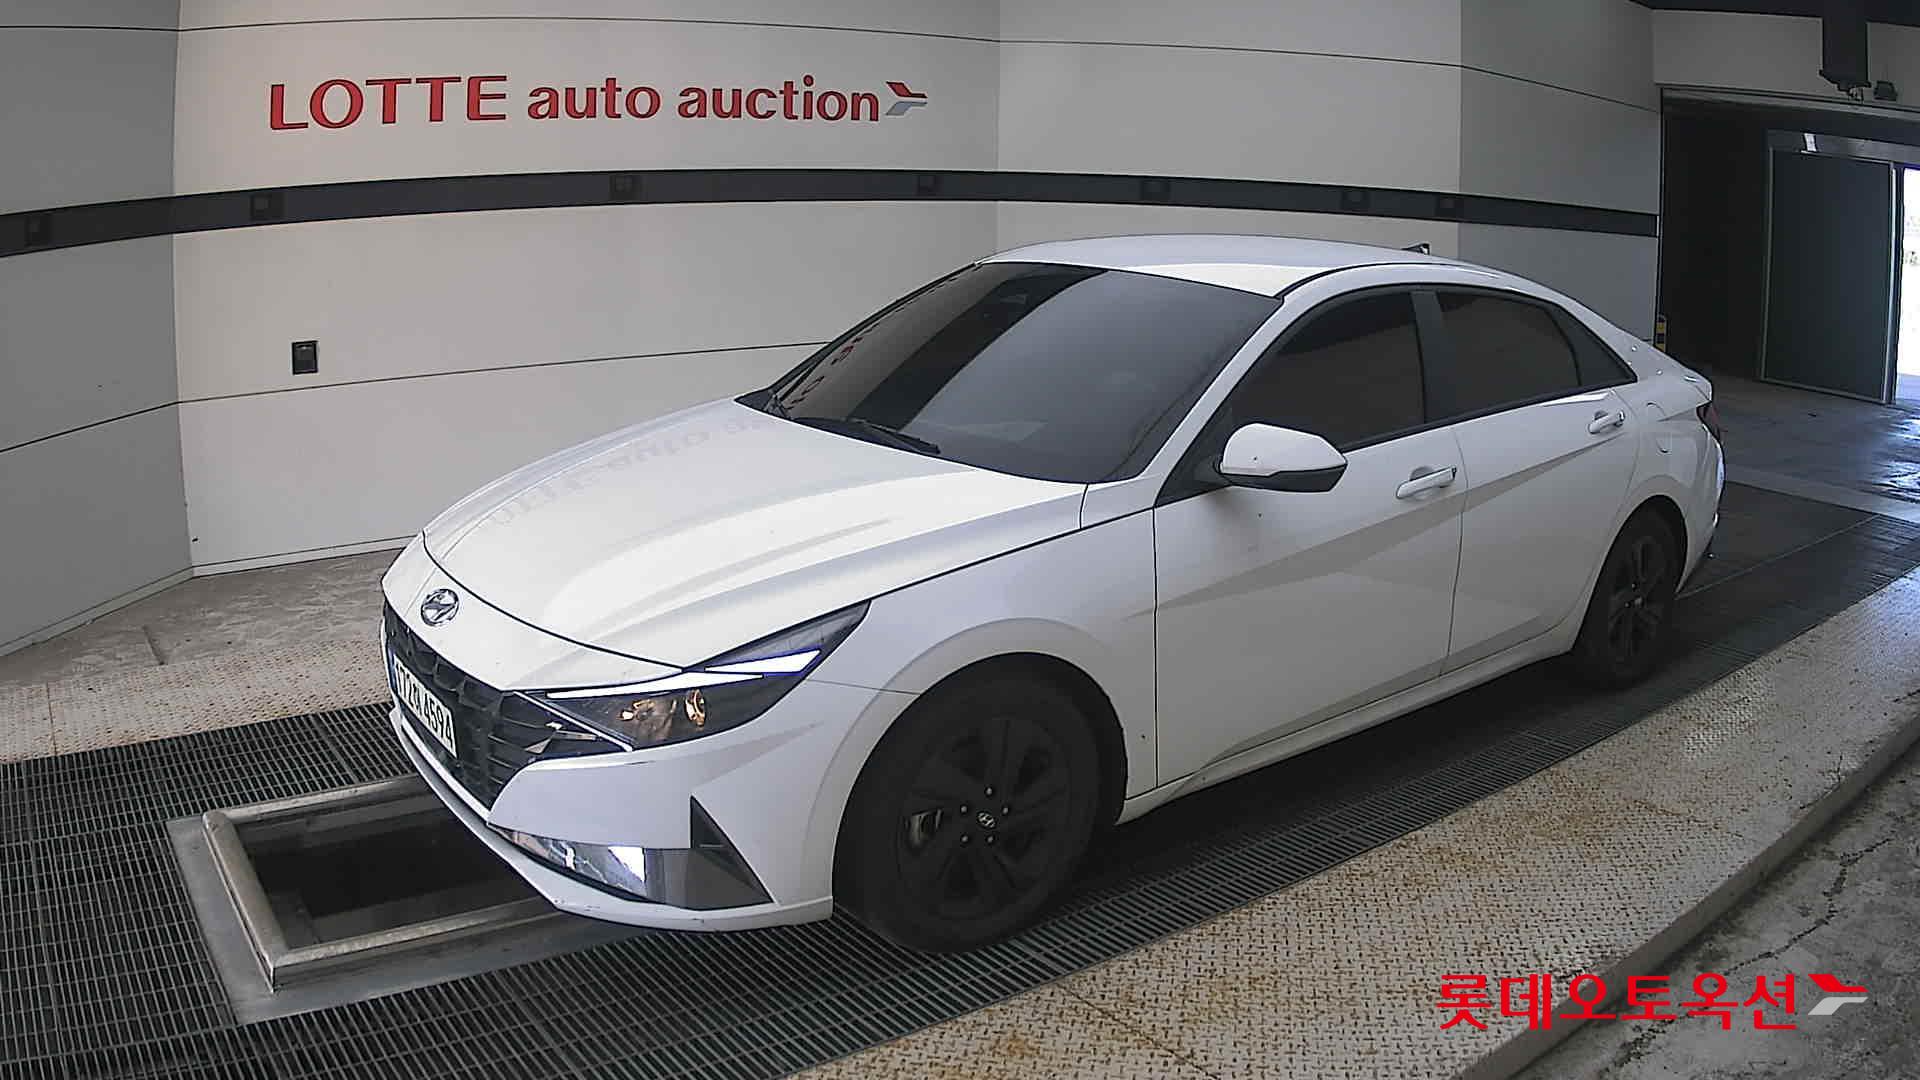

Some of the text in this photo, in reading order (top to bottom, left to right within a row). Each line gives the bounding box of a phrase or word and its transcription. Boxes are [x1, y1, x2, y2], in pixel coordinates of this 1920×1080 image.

[269, 75, 880, 131] LOTTE auto auction
[423, 692, 454, 749] 4594
